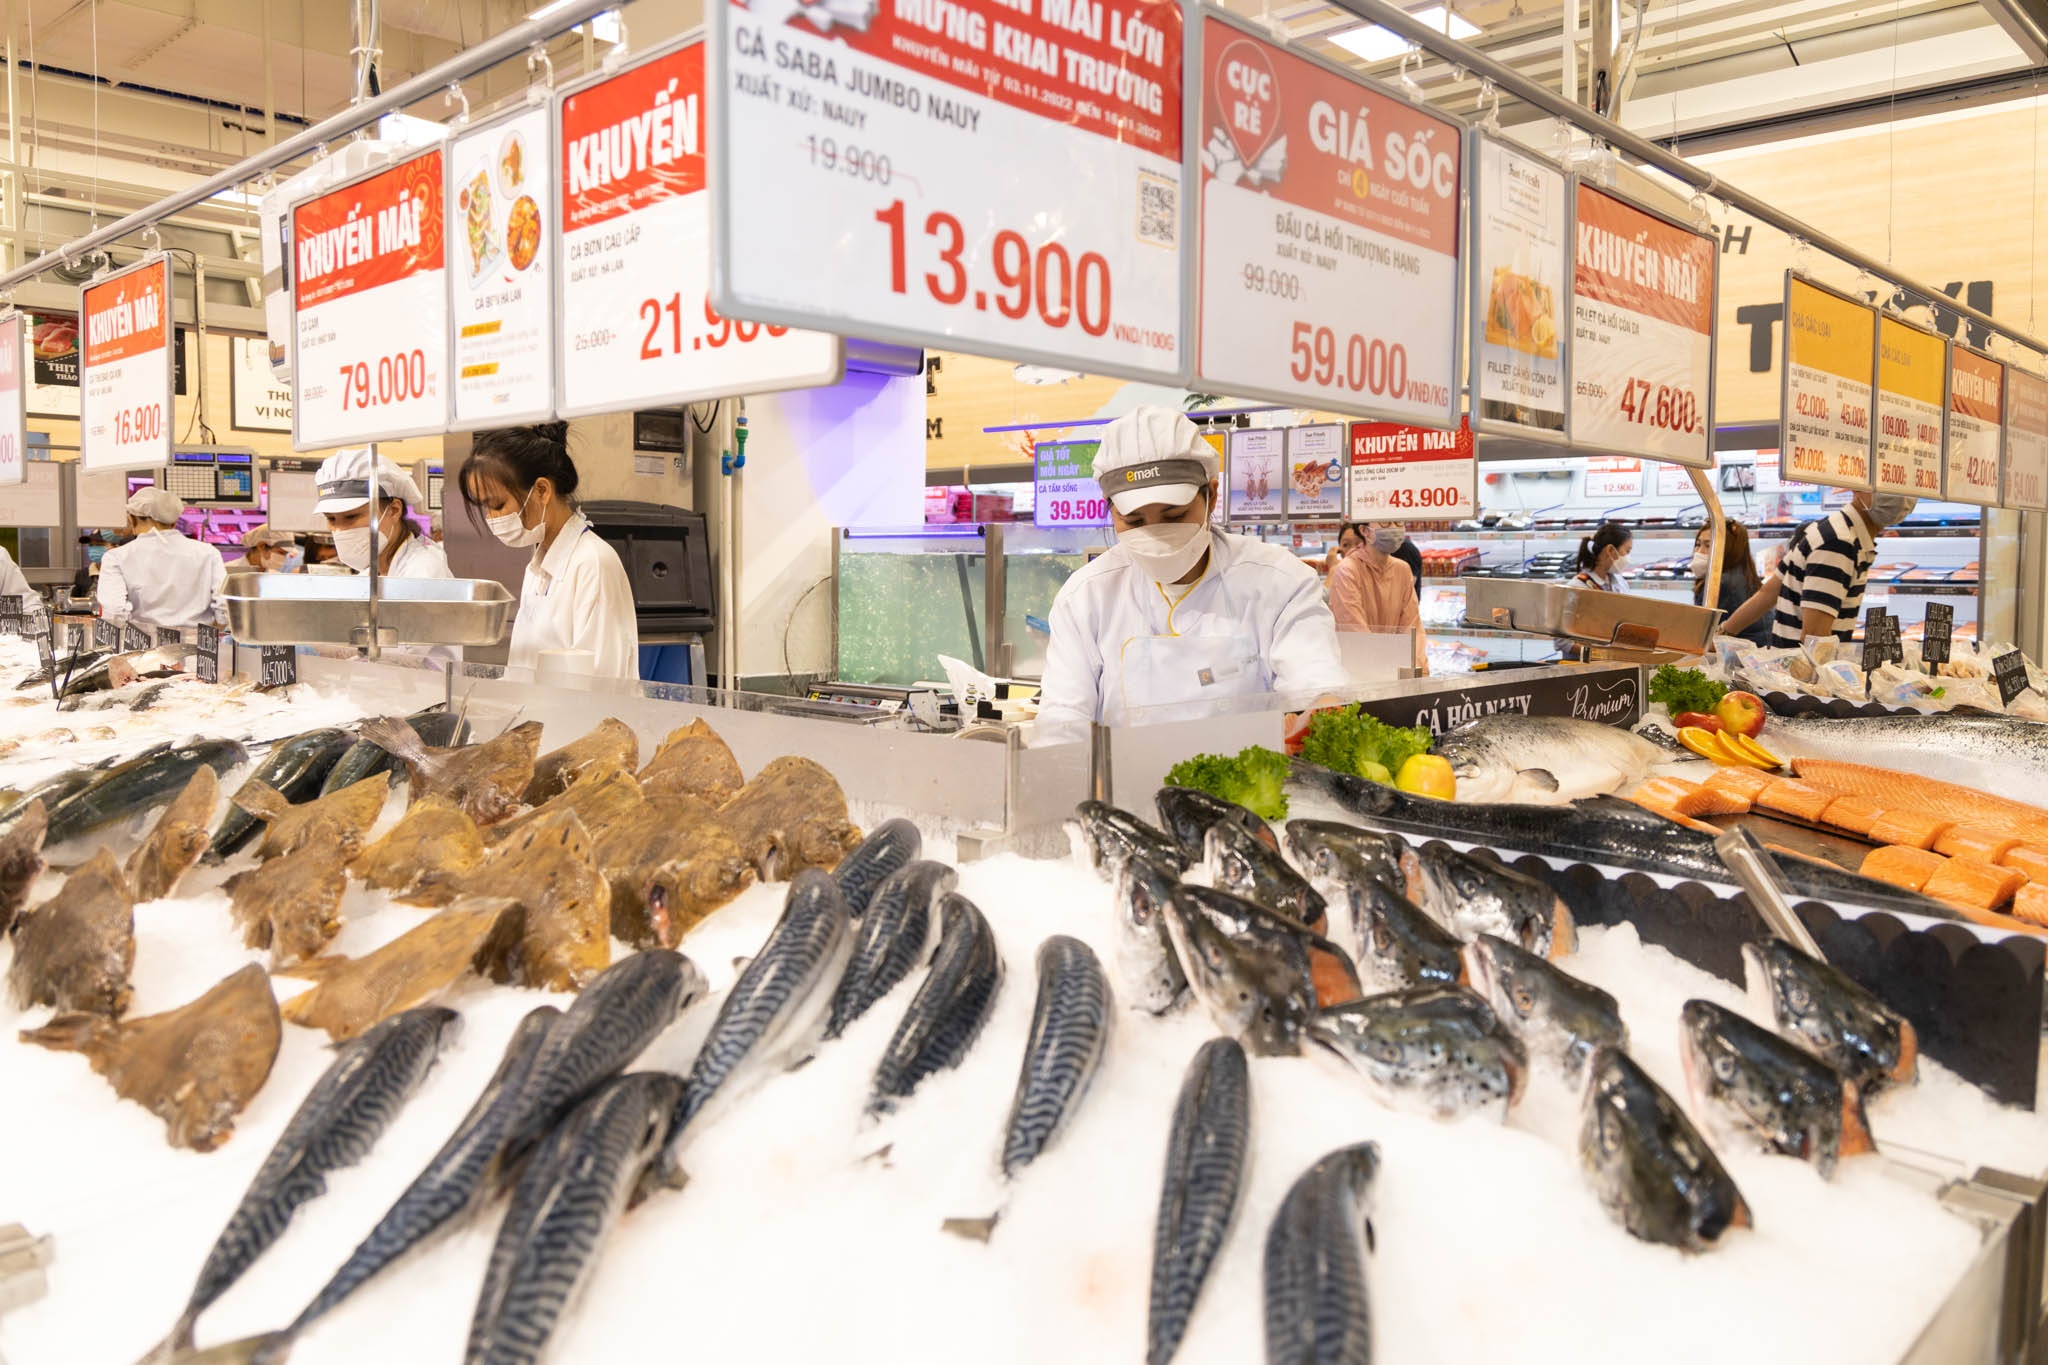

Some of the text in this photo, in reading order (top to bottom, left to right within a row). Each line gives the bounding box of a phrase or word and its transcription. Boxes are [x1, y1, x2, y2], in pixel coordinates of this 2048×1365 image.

[993, 22, 1058, 77] KHAI
[1110, 9, 1164, 67] LỚN
[735, 25, 981, 132] CÁ SABA JUMBO NAUY
[735, 71, 781, 103] XUẤT
[822, 99, 867, 130] NAUY
[1226, 60, 1272, 106] CỰC
[569, 78, 698, 195] KHUYẾN
[1234, 100, 1262, 137] RẺ
[807, 134, 892, 187] 19.900
[1308, 100, 1374, 170] GIÁ
[1384, 129, 1454, 200] SỐC
[299, 188, 421, 283] KHUYẾN MÃI
[875, 199, 1112, 338] 13.900
[1243, 262, 1300, 301] 99.000
[1577, 221, 1658, 291] KHUYẾN
[1664, 257, 1698, 305] MÃI
[89, 285, 159, 347] KHUYẾN MÃI
[639, 291, 790, 361] 21.9
[48, 363, 76, 376] THỊT
[339, 348, 425, 411] 79.000
[1290, 320, 1408, 400] 59.000
[1487, 361, 1511, 375] FILLET
[1620, 377, 1696, 433] 47.600
[1953, 367, 1984, 403] KHUYẾN
[114, 403, 160, 446] 16.900
[255, 406, 269, 419] VỊ
[1796, 392, 1825, 420] 42.000
[1840, 403, 1865, 429] 45.000
[1882, 414, 1907, 439] 109.000
[1354, 428, 1418, 456] KHUYẾN
[1794, 446, 1825, 473] 50.000
[1838, 453, 1865, 478] 95.000
[1126, 466, 1160, 482] emart
[1881, 463, 1937, 489] 56.000 58.000
[1967, 456, 1996, 487] 42.000
[1050, 499, 1106, 520] 39.500
[1389, 487, 1458, 509] 43.900
[1415, 698, 1442, 737] CÁ
[1567, 678, 1637, 726] Premium
